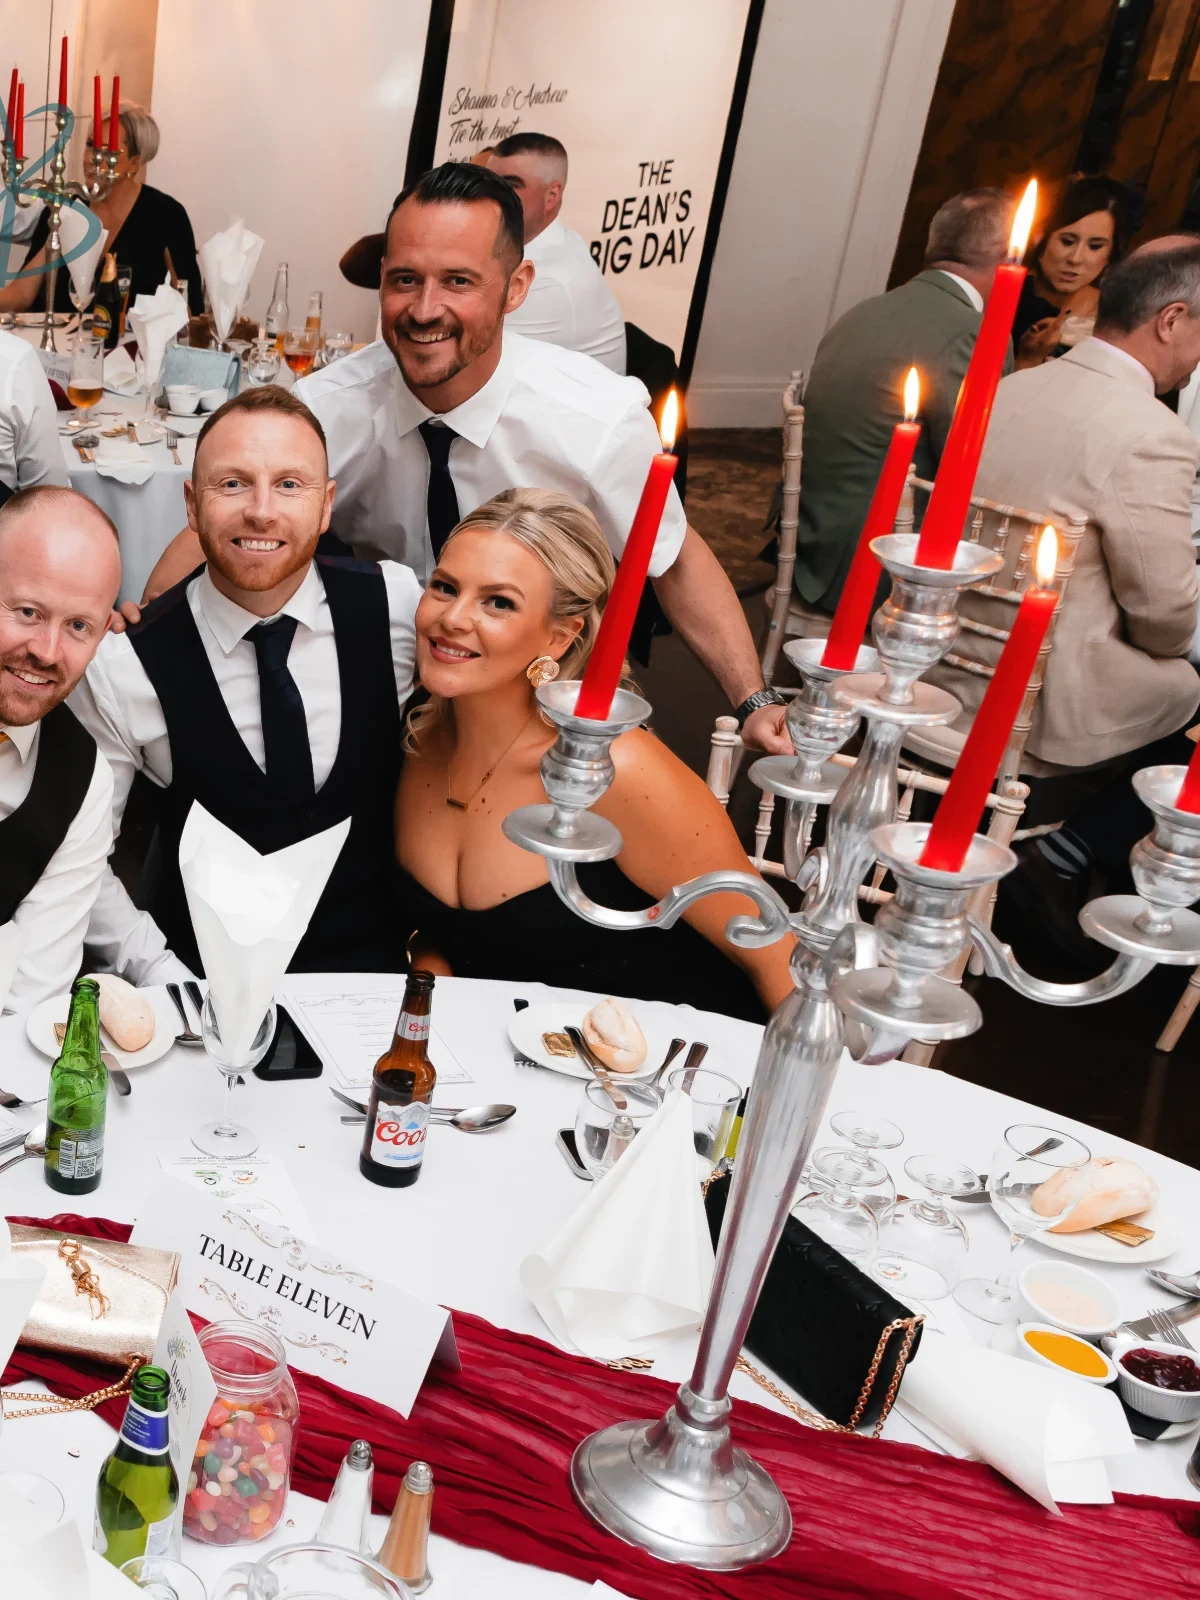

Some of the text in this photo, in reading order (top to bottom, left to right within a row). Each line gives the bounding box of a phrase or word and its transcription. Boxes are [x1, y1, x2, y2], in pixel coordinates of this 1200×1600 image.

[513, 82, 568, 110] Andrew
[449, 116, 522, 146] Tie the knot
[638, 159, 675, 188] THE
[601, 189, 692, 233] DEAN'S
[639, 226, 696, 269] DAY
[198, 1233, 378, 1342] TABLE ELEVEN
